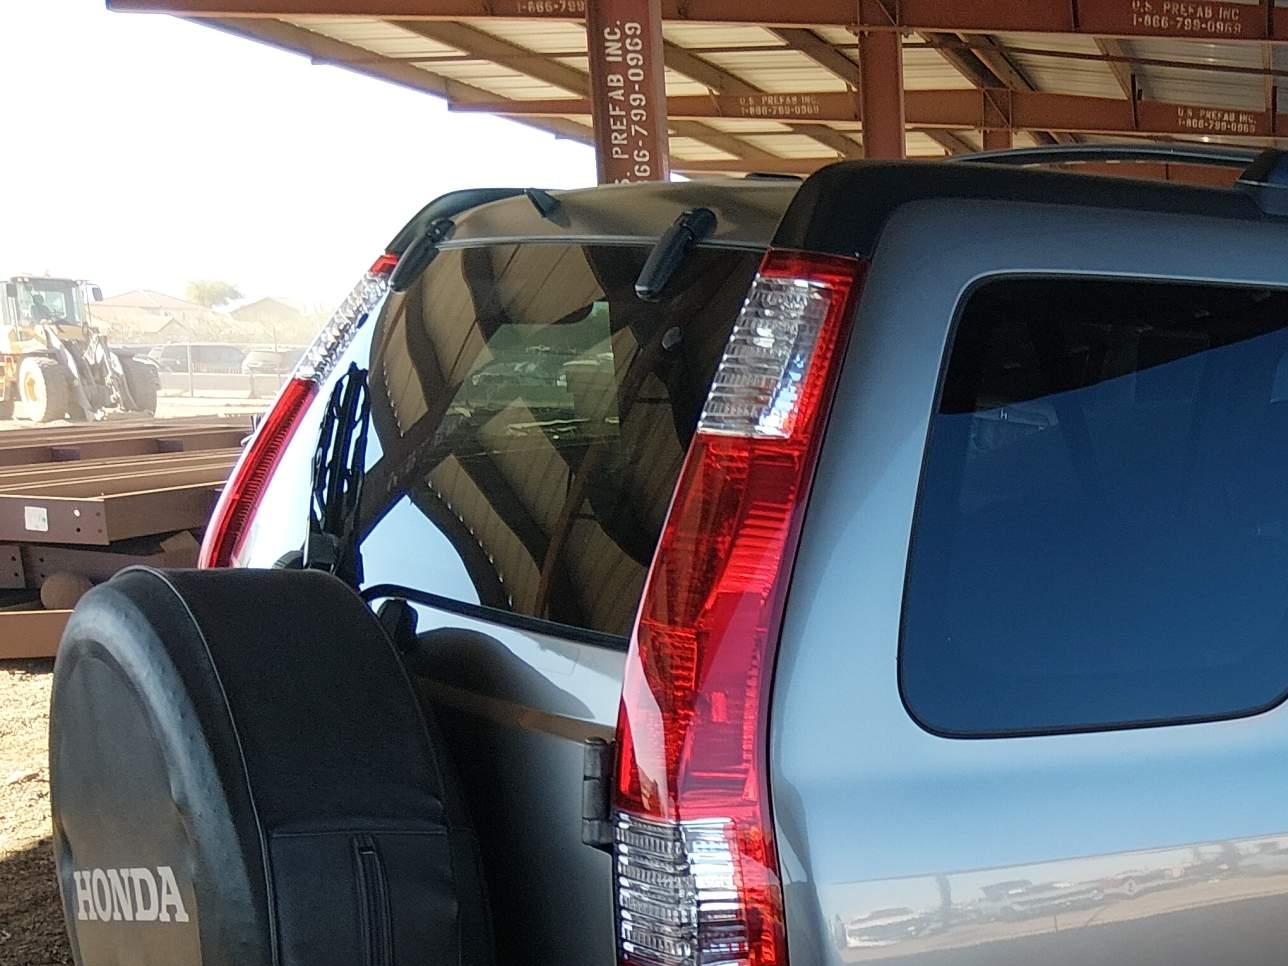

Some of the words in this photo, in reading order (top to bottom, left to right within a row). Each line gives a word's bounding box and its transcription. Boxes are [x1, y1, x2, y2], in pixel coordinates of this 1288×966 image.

[1163, 2, 1213, 19] PREFAB
[604, 20, 623, 62] INC.
[607, 74, 629, 159] PREFAB
[625, 22, 651, 184] 66-799-0969
[73, 866, 189, 923] HONDA
